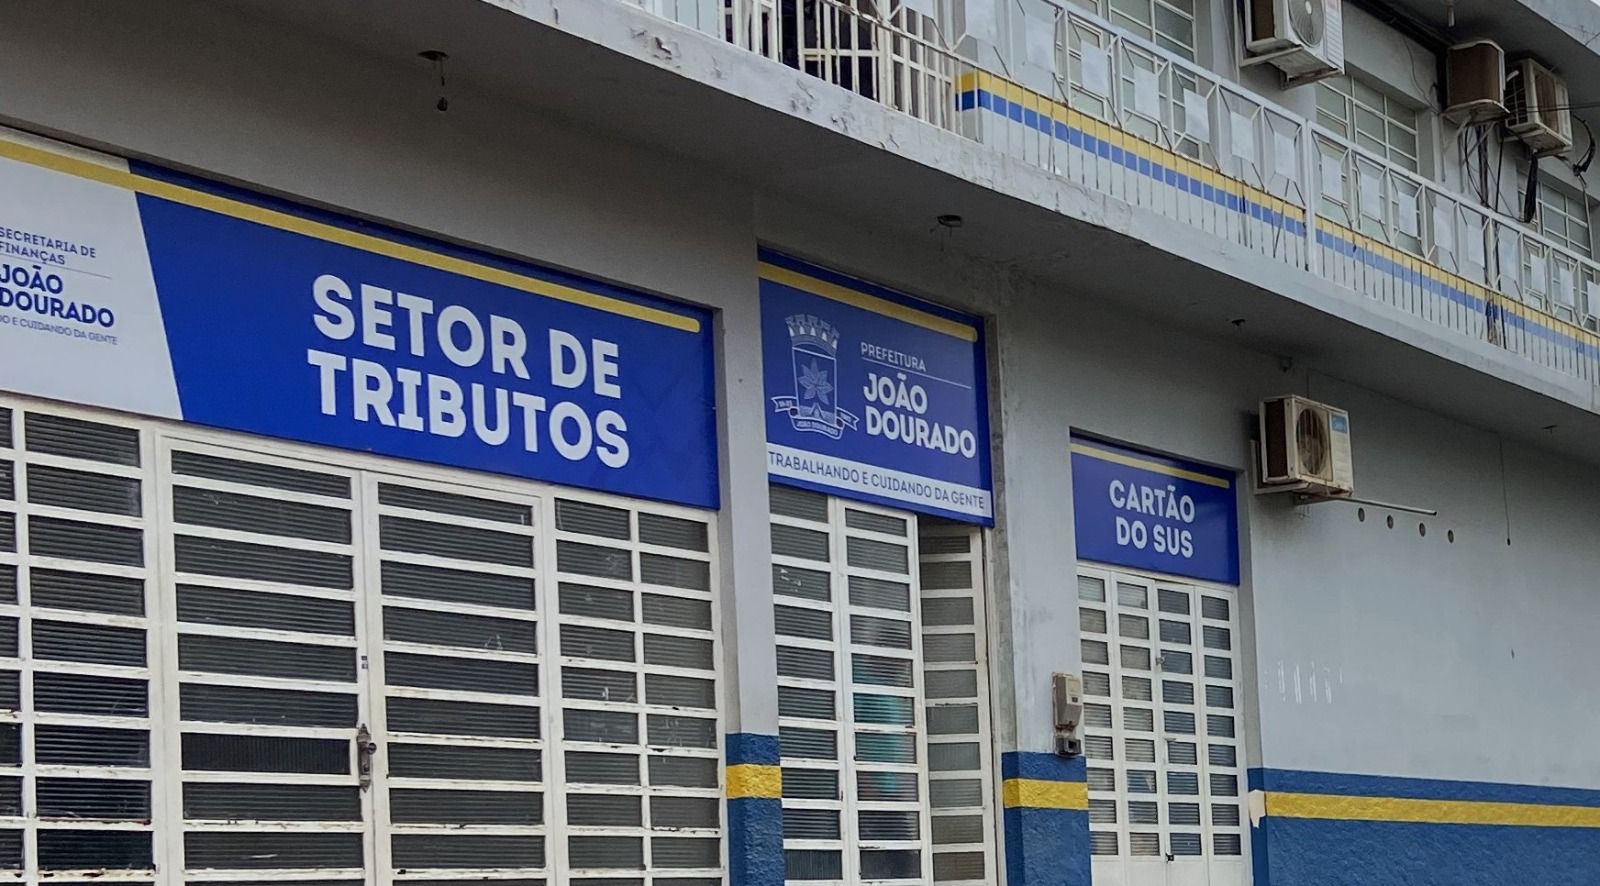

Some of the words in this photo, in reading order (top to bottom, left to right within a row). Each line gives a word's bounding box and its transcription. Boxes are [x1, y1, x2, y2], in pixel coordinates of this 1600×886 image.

[0, 226, 77, 254] SECRETARIA
[81, 246, 96, 258] DE
[0, 264, 63, 294] JOÃO
[0, 287, 114, 328] DOURADO
[12, 317, 18, 325] E
[20, 318, 72, 335] CUIDANDO
[74, 329, 87, 338] DA
[88, 332, 118, 346] GENTE
[312, 274, 531, 380] SETOR
[549, 328, 621, 399] DE
[861, 341, 926, 372] PREFEITURA
[308, 349, 629, 468] TRIBUTOS
[864, 372, 928, 414] JOÃO
[865, 406, 976, 459] DOURADO
[769, 451, 859, 483] TRABALHANDO
[863, 472, 869, 485] E
[871, 474, 929, 498] CUIDANDO
[935, 487, 949, 501] DA
[951, 490, 985, 509] GENTE
[1109, 480, 1195, 523] CARTÃO
[1116, 516, 1147, 549] DO
[1153, 524, 1193, 558] SUS
